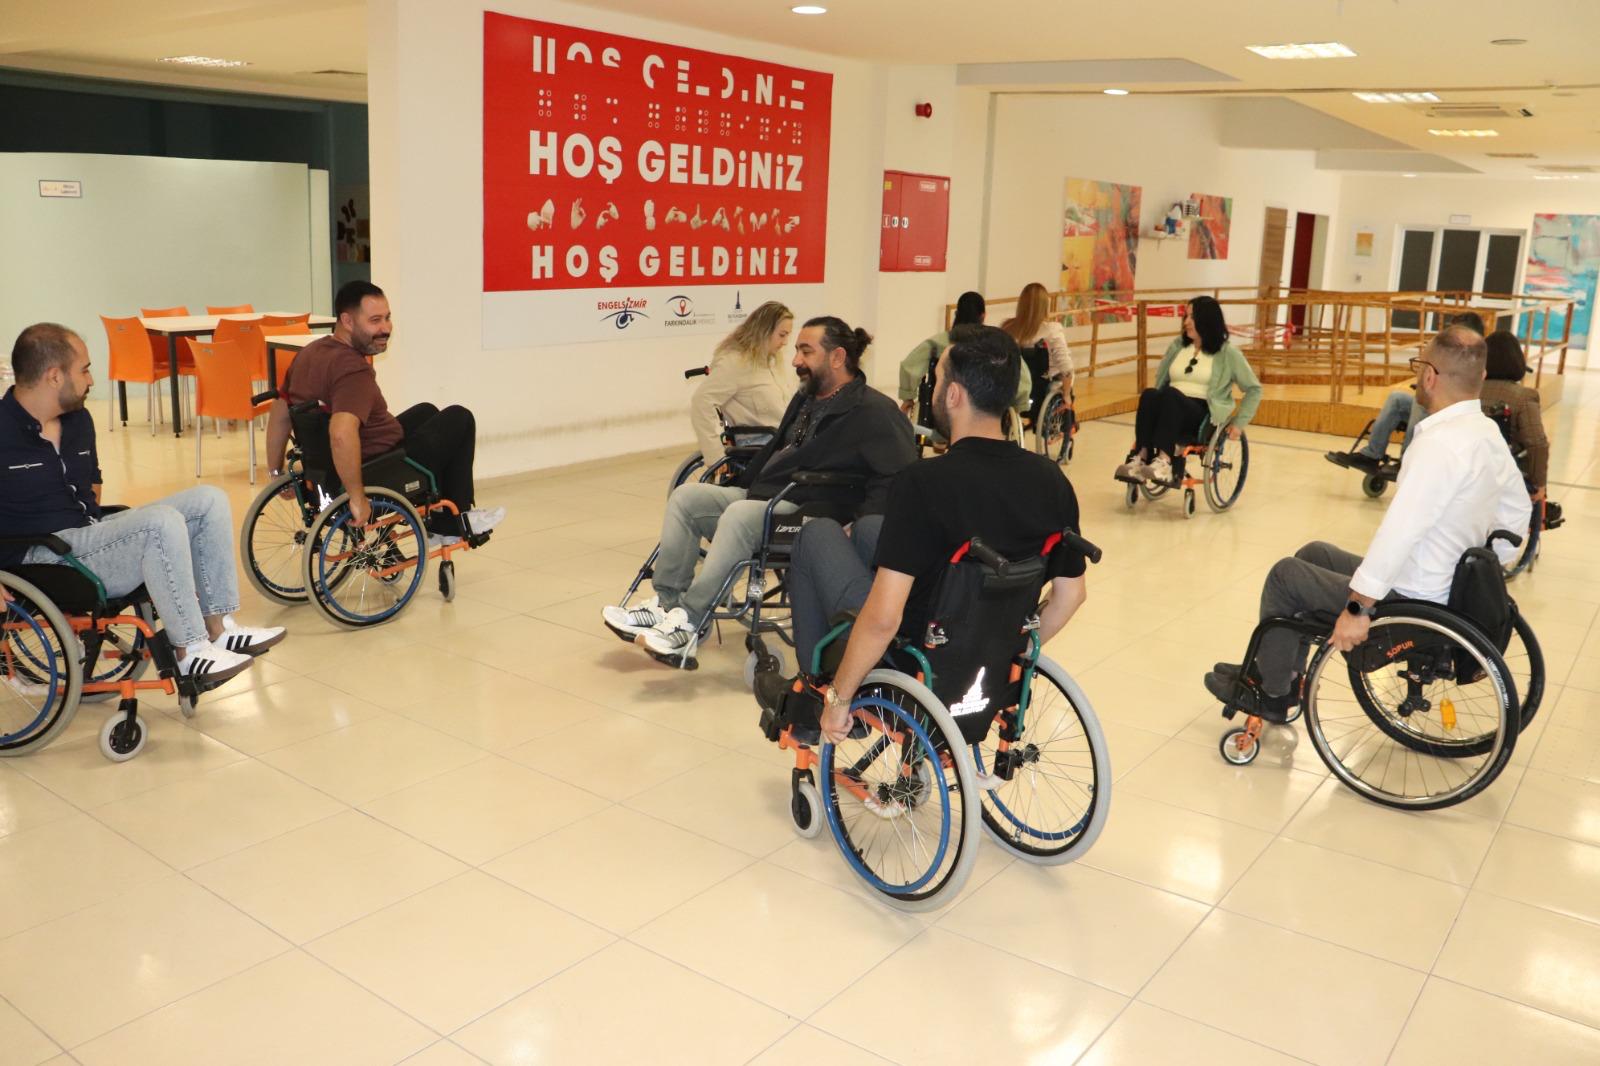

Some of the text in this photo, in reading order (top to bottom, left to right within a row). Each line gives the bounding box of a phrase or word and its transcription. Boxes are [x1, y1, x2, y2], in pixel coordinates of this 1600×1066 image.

[529, 130, 623, 185] HOŞ
[531, 245, 619, 283] HOŞ
[1386, 640, 1414, 658] SOPUR
